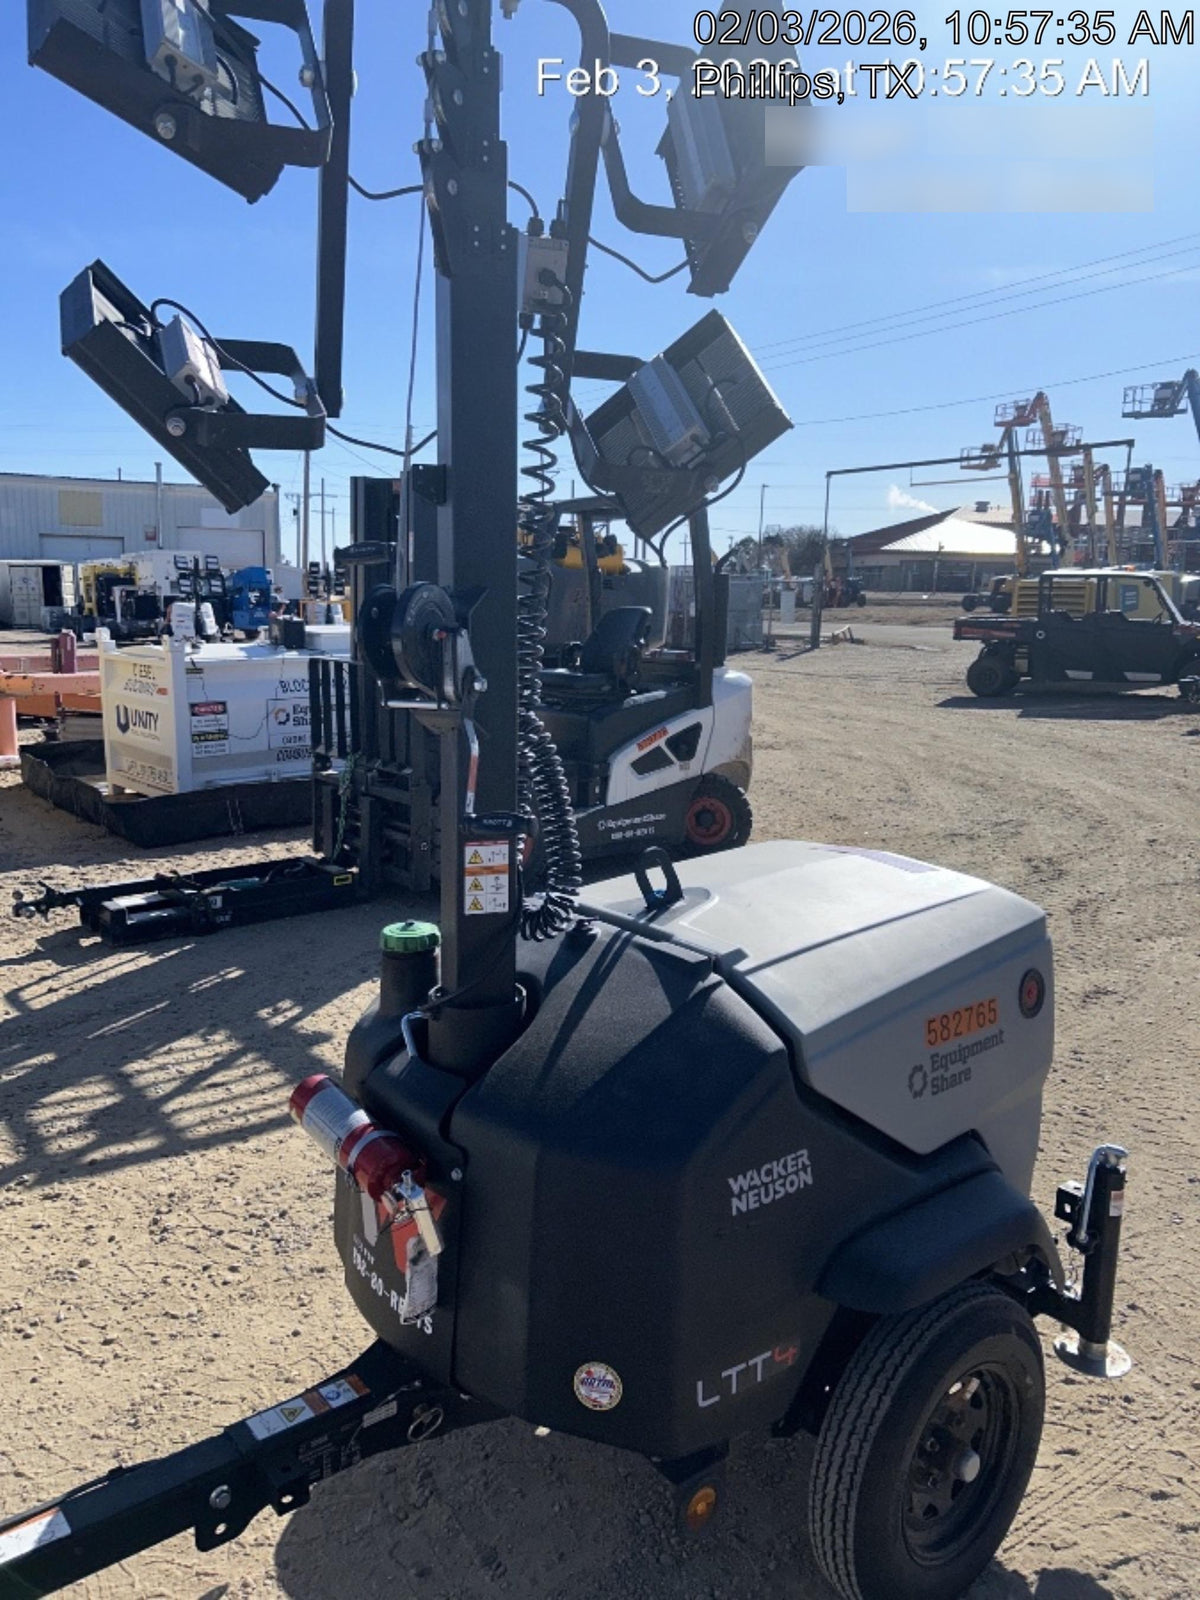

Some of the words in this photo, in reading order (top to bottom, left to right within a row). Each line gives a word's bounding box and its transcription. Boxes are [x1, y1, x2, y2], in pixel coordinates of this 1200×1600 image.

[926, 999, 998, 1046] 582765
[930, 1028, 1005, 1073] Equipment
[930, 1067, 972, 1097] Share
[727, 1148, 811, 1195] WACKER
[731, 1166, 813, 1217] NEUSON
